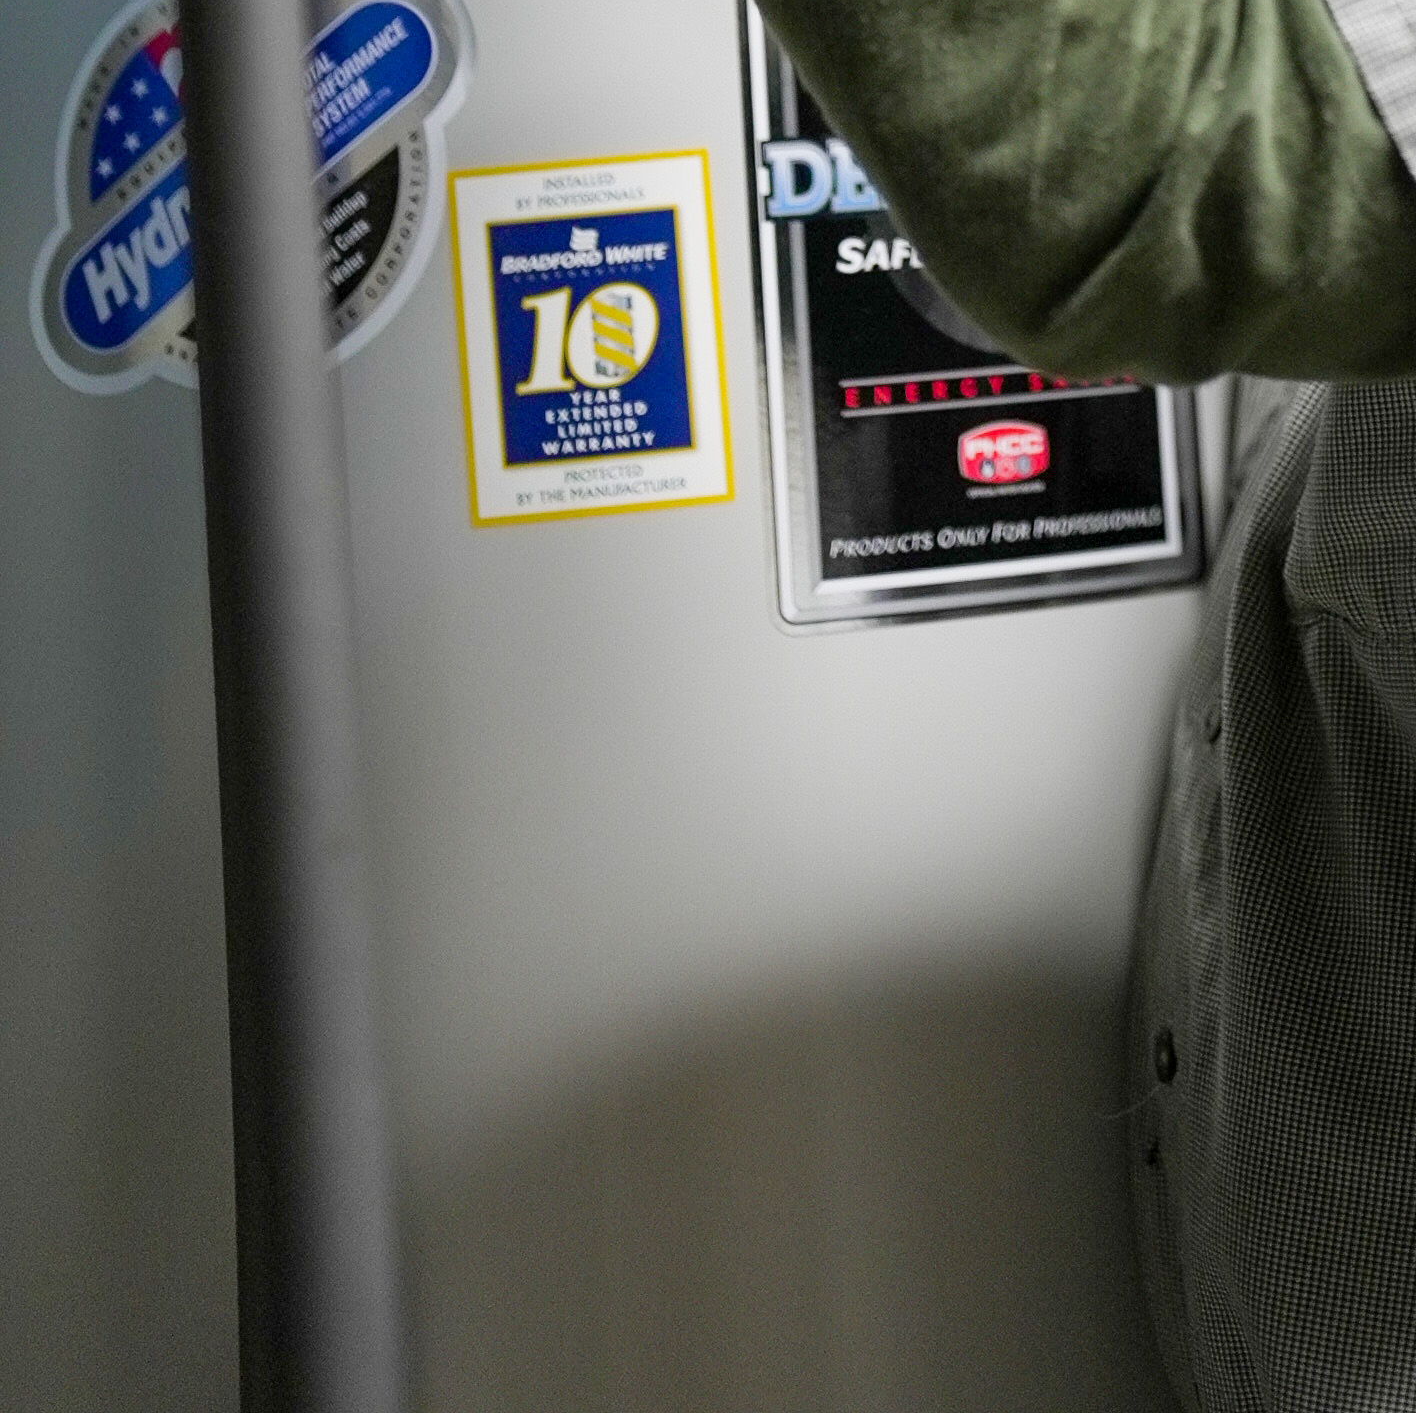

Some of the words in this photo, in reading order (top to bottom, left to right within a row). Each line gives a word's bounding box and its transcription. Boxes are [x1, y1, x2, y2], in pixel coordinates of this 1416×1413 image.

[764, 138, 889, 218] DE
[82, 184, 191, 324] Hydr
[500, 250, 603, 275] BRADFORD
[604, 241, 668, 266] WHITE
[515, 280, 661, 396] 10
[569, 388, 622, 406] YEAR
[844, 374, 1004, 409] ENERGY
[544, 400, 649, 424] EXTENDED
[556, 417, 639, 439] LIMITED
[541, 431, 656, 456] WARRANTY
